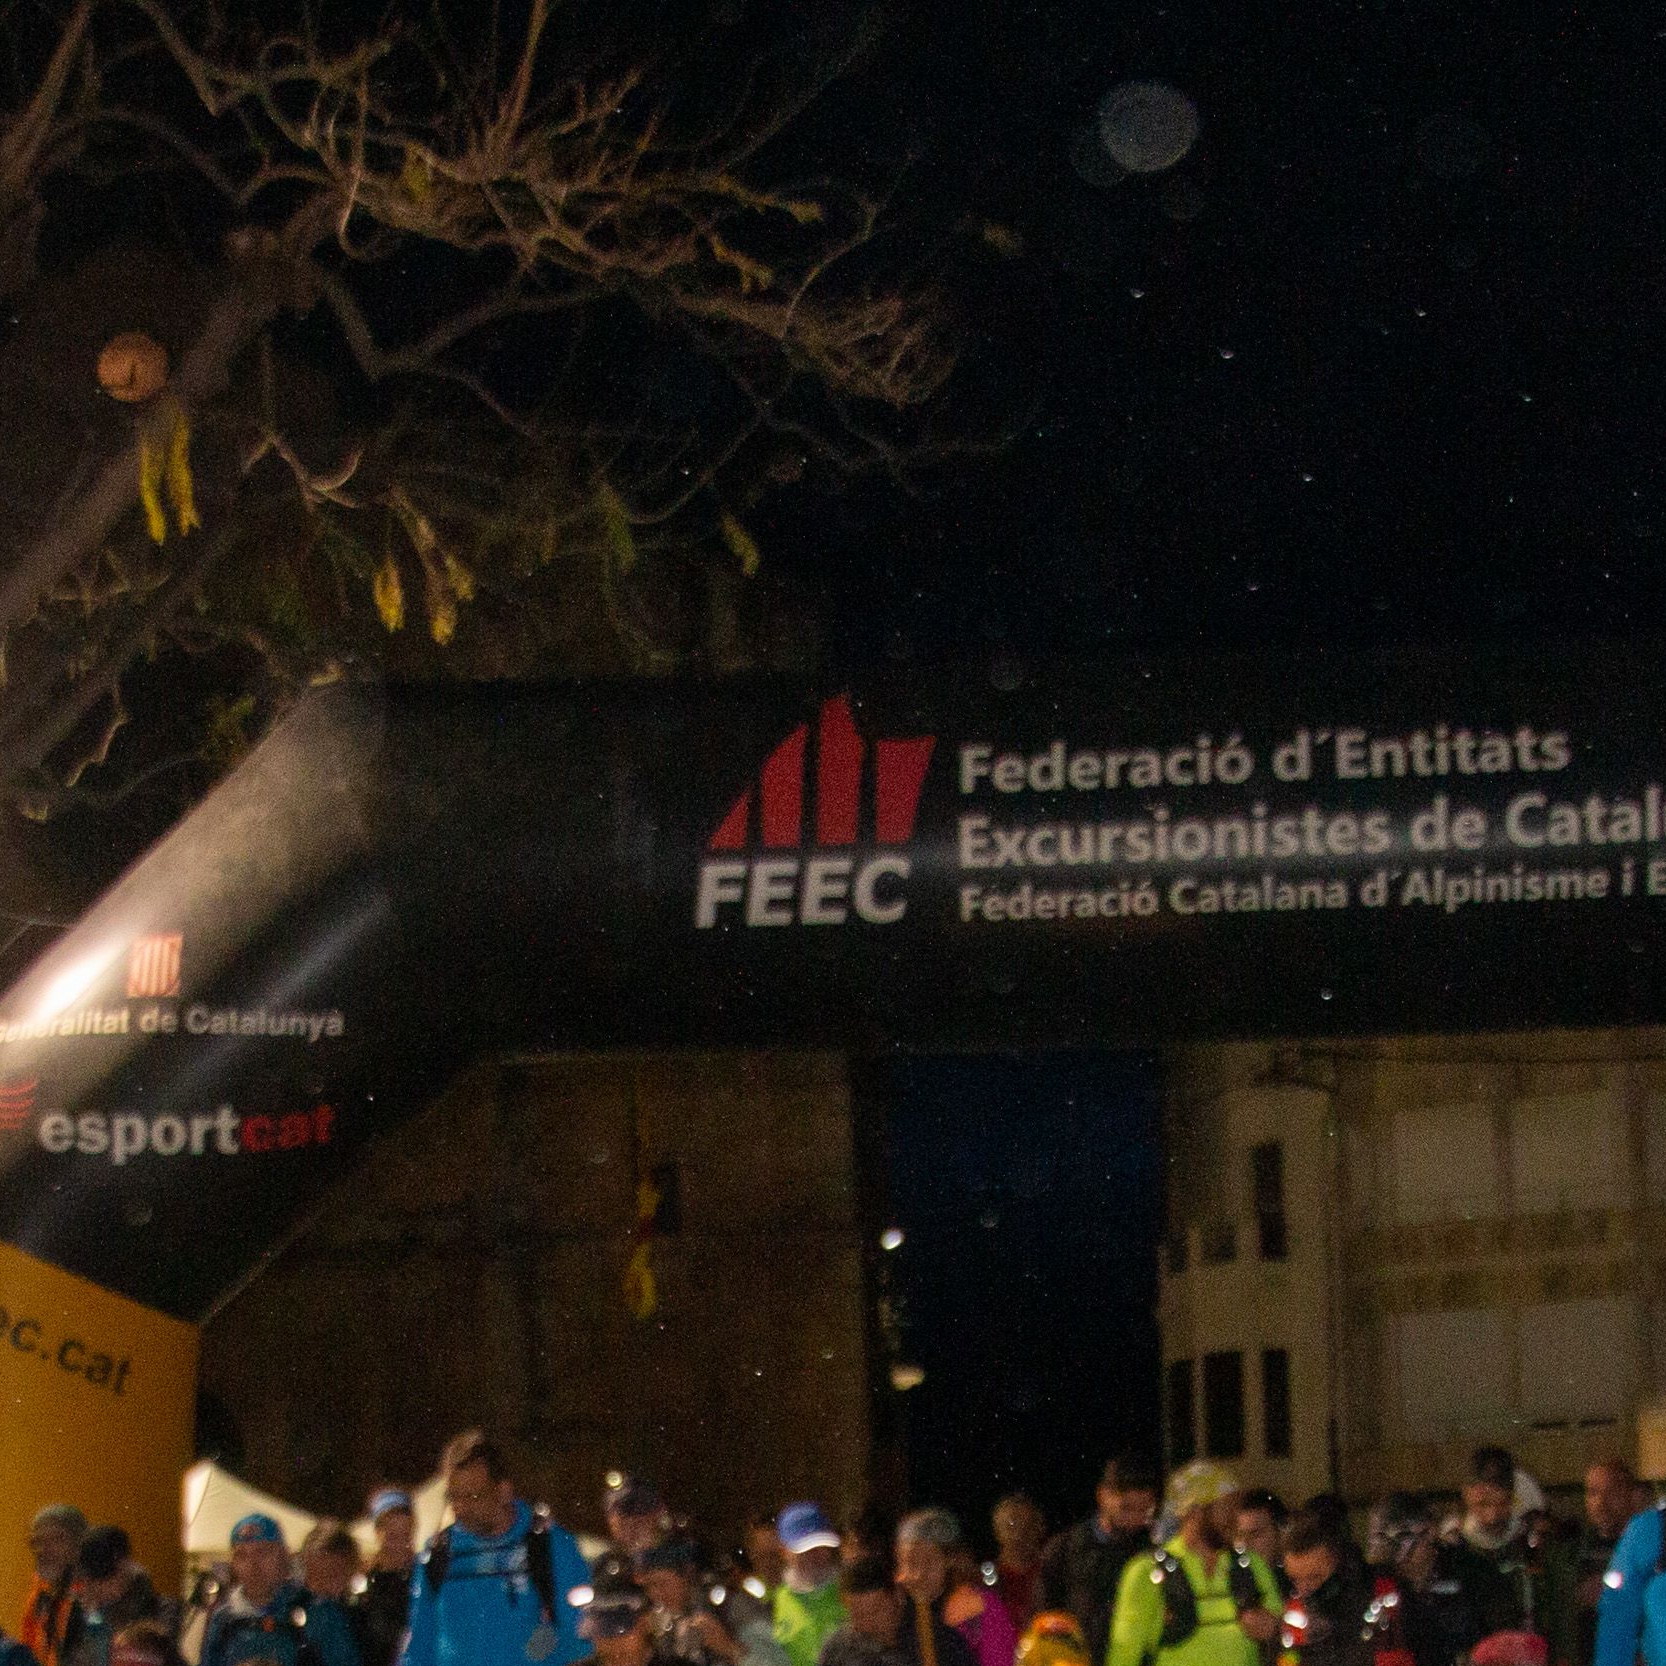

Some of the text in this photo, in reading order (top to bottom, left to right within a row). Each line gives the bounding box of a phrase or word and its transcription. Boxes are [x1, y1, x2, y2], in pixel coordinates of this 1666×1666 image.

[958, 730, 1256, 795] Federació
[957, 802, 1393, 868] Excursionistes
[1409, 794, 1488, 852] de
[694, 855, 912, 930] FEEC
[958, 881, 1161, 924] Federació
[1168, 872, 1351, 915] Catalana
[1620, 859, 1634, 897] i
[137, 1004, 180, 1036] de
[185, 1003, 347, 1045] Catalunya
[36, 1102, 336, 1167] esportcat
